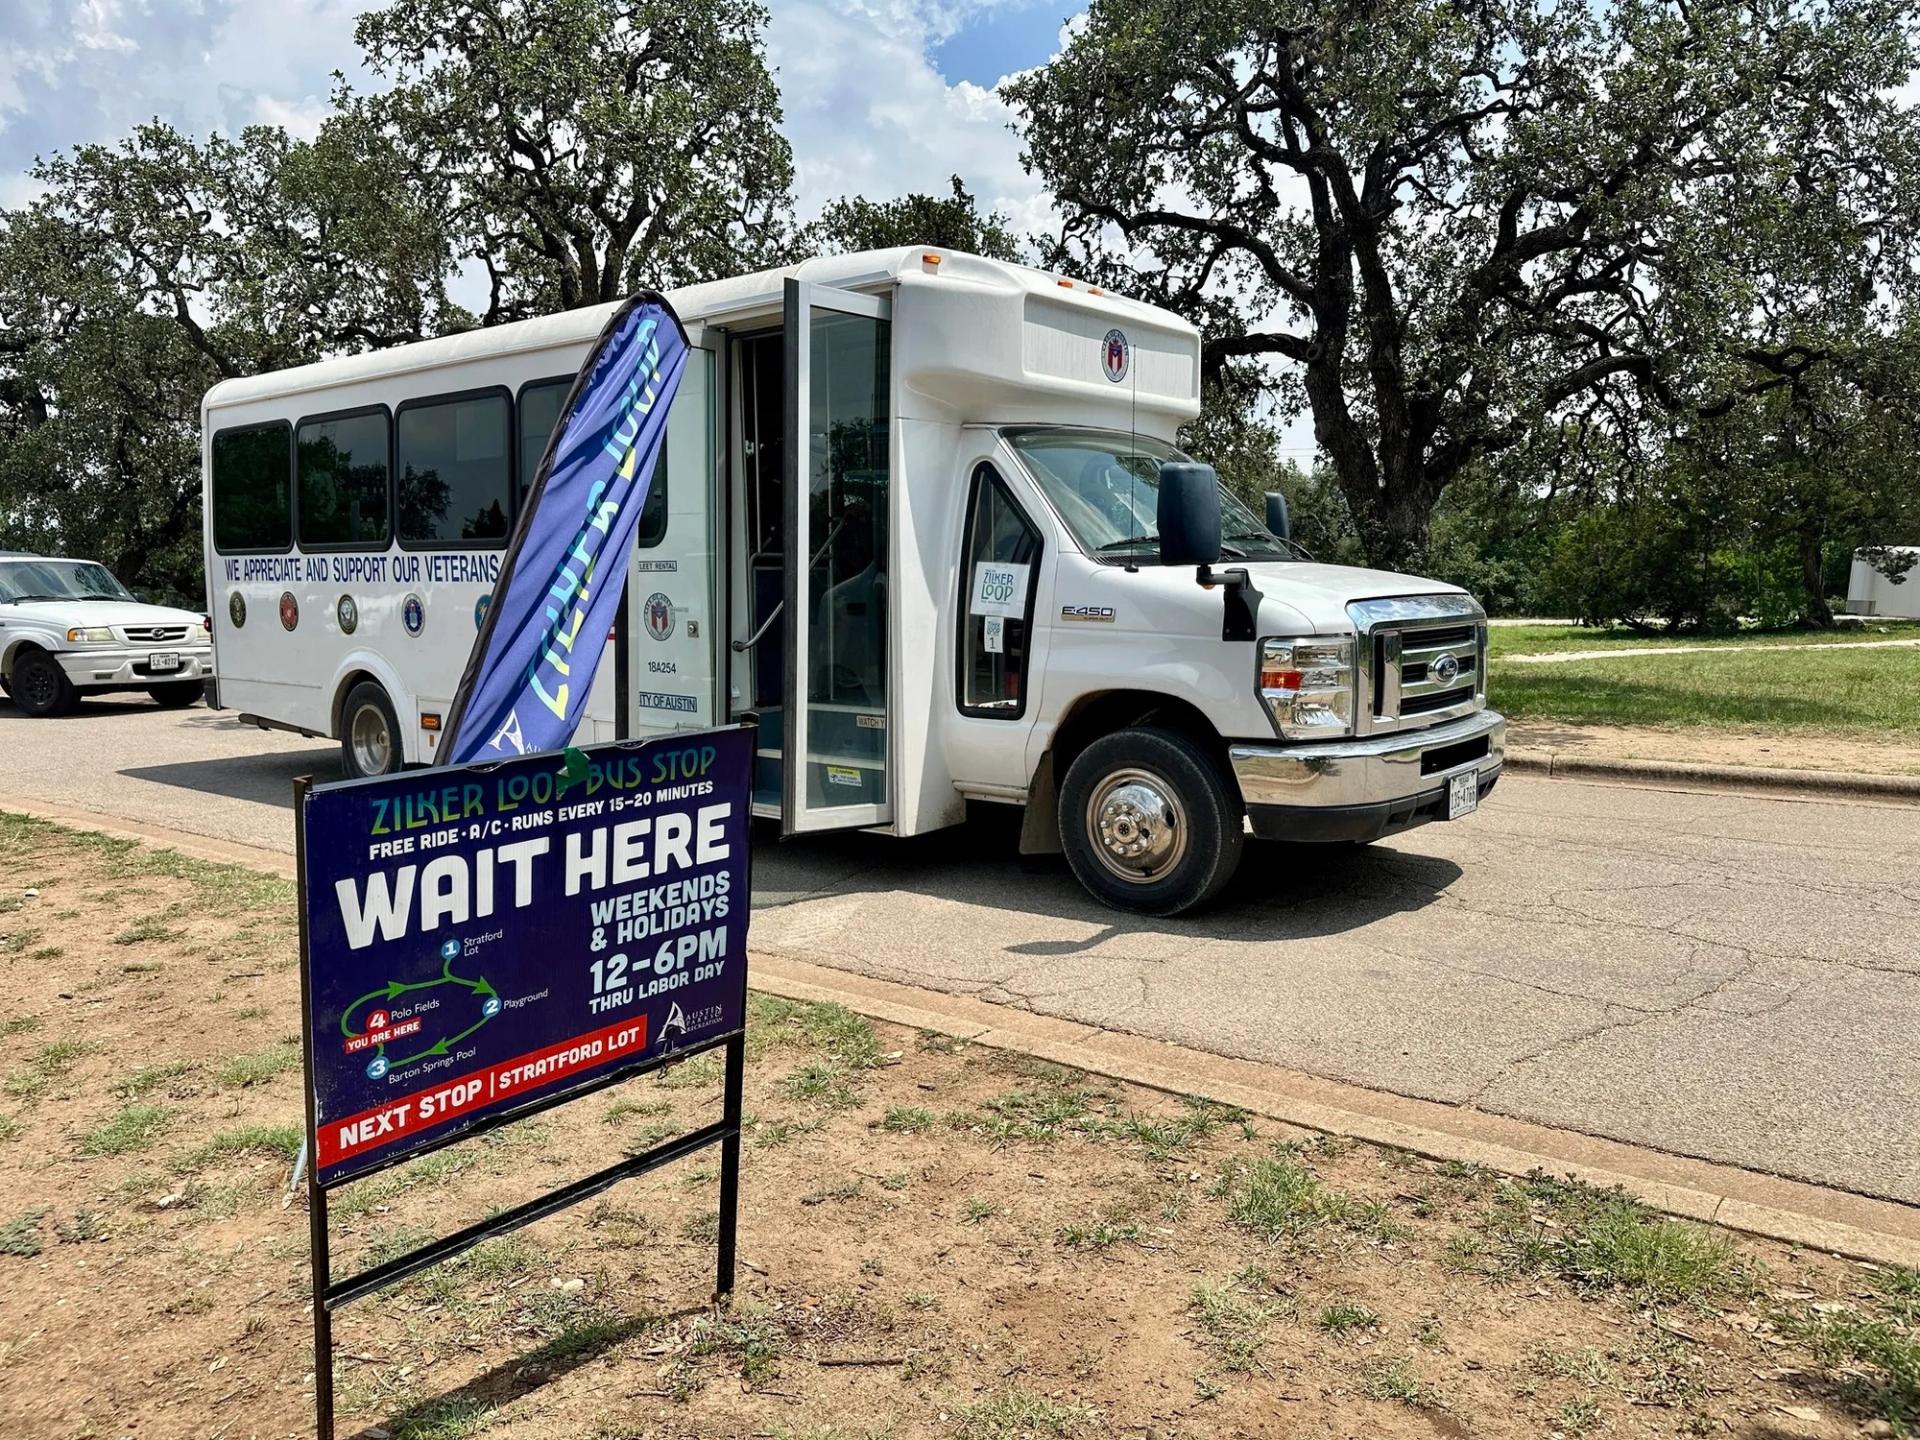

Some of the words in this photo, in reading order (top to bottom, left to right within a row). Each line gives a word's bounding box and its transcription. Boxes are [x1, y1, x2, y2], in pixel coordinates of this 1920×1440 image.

[225, 558, 240, 581] WE
[244, 558, 301, 581] APPRECIATE
[306, 557, 328, 582] AND
[333, 556, 387, 582] SUPPORT
[393, 556, 420, 582] OUR
[425, 554, 500, 583] VETERANS
[984, 572, 1013, 586] ZILKER
[981, 584, 1013, 601] LOOP
[990, 637, 996, 649] 1
[648, 661, 676, 674] 18A254
[640, 694, 651, 705] ITY
[666, 697, 695, 711] AUSTIN
[370, 784, 485, 835] ZILKER
[498, 771, 566, 812] LOO
[586, 757, 642, 796] BUS
[651, 746, 717, 784] STOP
[369, 837, 415, 860] FREE
[420, 828, 459, 850] RIDE
[469, 820, 502, 840] A/C
[511, 810, 554, 832] RUNS
[558, 800, 604, 822] EVERY
[656, 780, 714, 803] MINUTES
[335, 837, 550, 950] WAIT
[564, 802, 732, 897] HERE
[590, 870, 730, 927] WEEKENDS
[590, 927, 608, 952] &
[617, 895, 730, 945] HOLIDAYS
[444, 942, 458, 955] 1
[464, 929, 504, 948] Stratford
[464, 945, 479, 957] Lot
[486, 1000, 499, 1014] 2
[503, 988, 549, 1010] Playground
[588, 987, 634, 1014] THRU
[638, 971, 690, 999] LABOR
[694, 960, 725, 982] DAY
[369, 1013, 386, 1028] 4
[391, 1006, 412, 1021] Polo
[415, 999, 440, 1013] Fields
[686, 1004, 723, 1021] AUSTIN
[348, 1037, 369, 1051] YOU
[373, 1031, 391, 1043] ARE
[394, 1021, 420, 1036] HERE
[371, 1060, 386, 1076] 3
[389, 1067, 421, 1084] Barton
[422, 1056, 454, 1074] Springs
[457, 1047, 476, 1061] Pool
[340, 1104, 411, 1149] NEXT
[419, 1079, 483, 1119] STOP
[499, 1040, 603, 1089] STRATFORD
[608, 1026, 640, 1052] LOT
